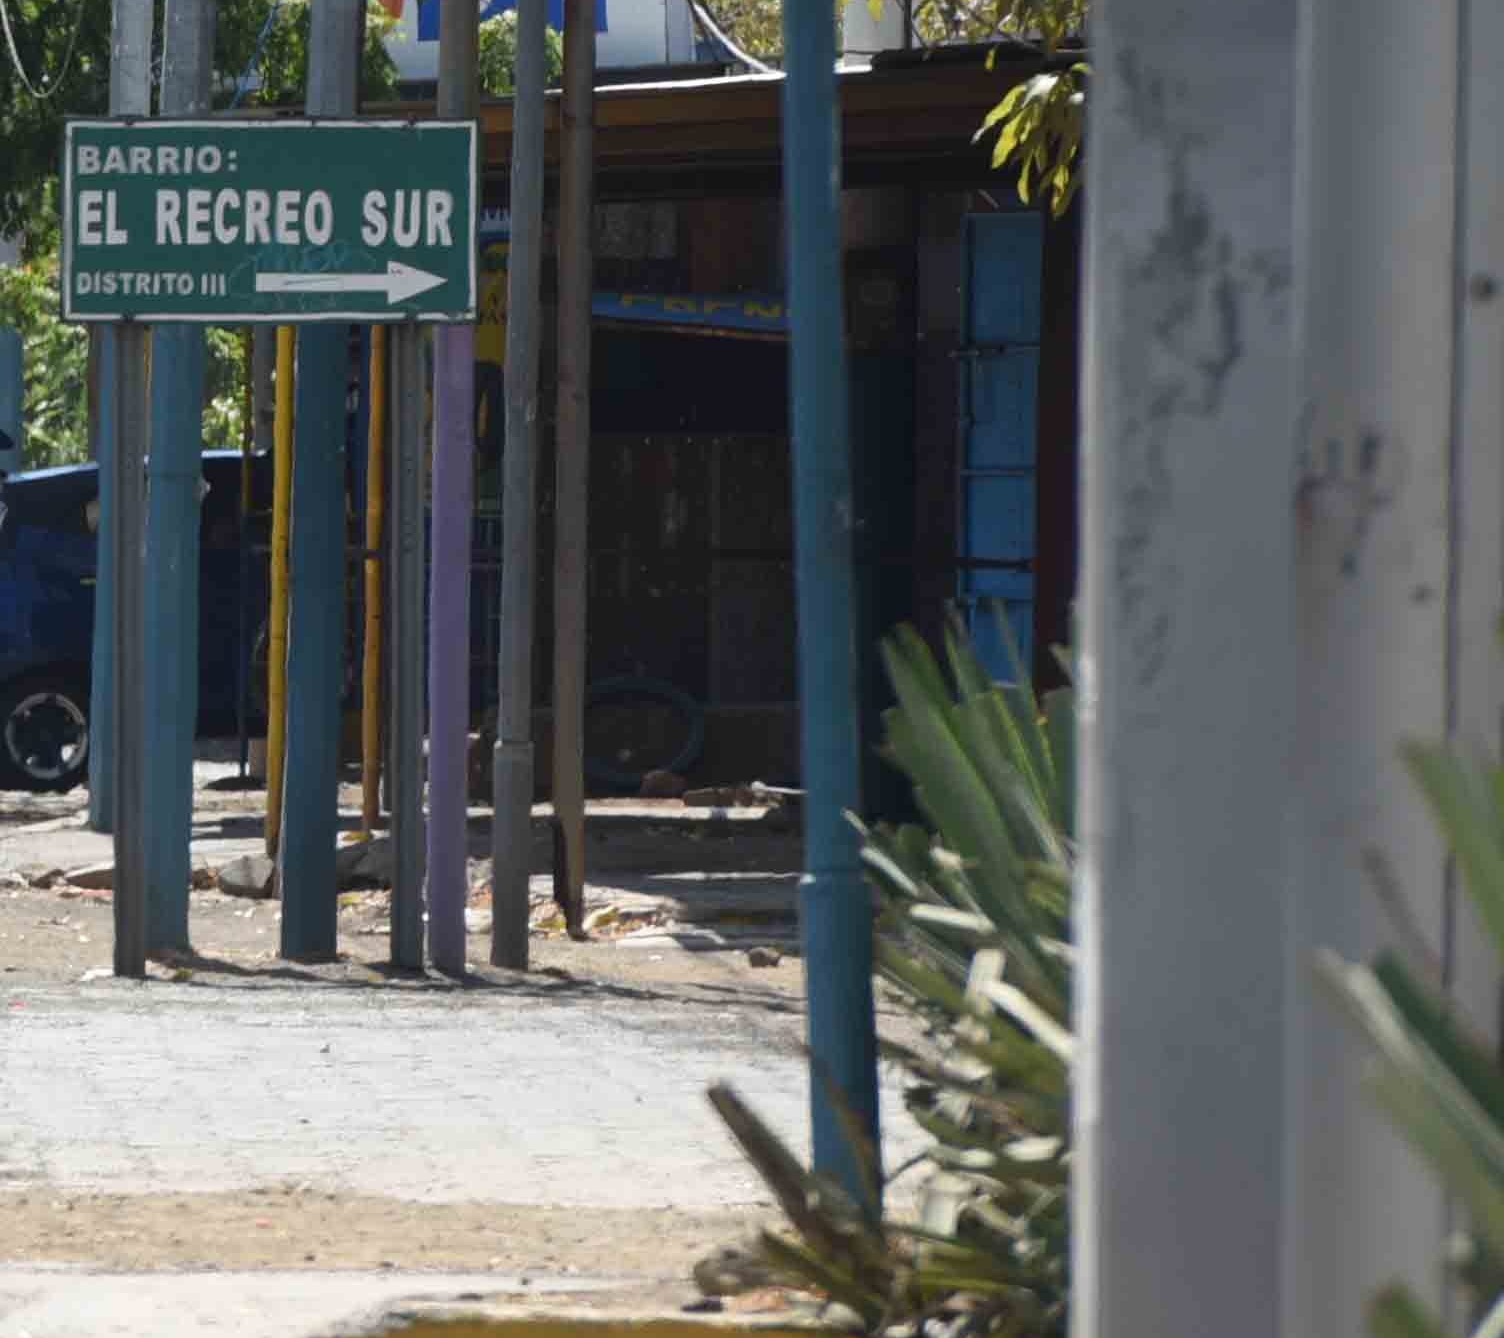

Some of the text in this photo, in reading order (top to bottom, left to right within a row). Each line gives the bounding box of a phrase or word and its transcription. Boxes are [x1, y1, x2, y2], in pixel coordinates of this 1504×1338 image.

[76, 145, 238, 174] BARRIO:
[78, 188, 454, 248] EL RECREO SUR
[76, 270, 227, 297] DISTRITO III
